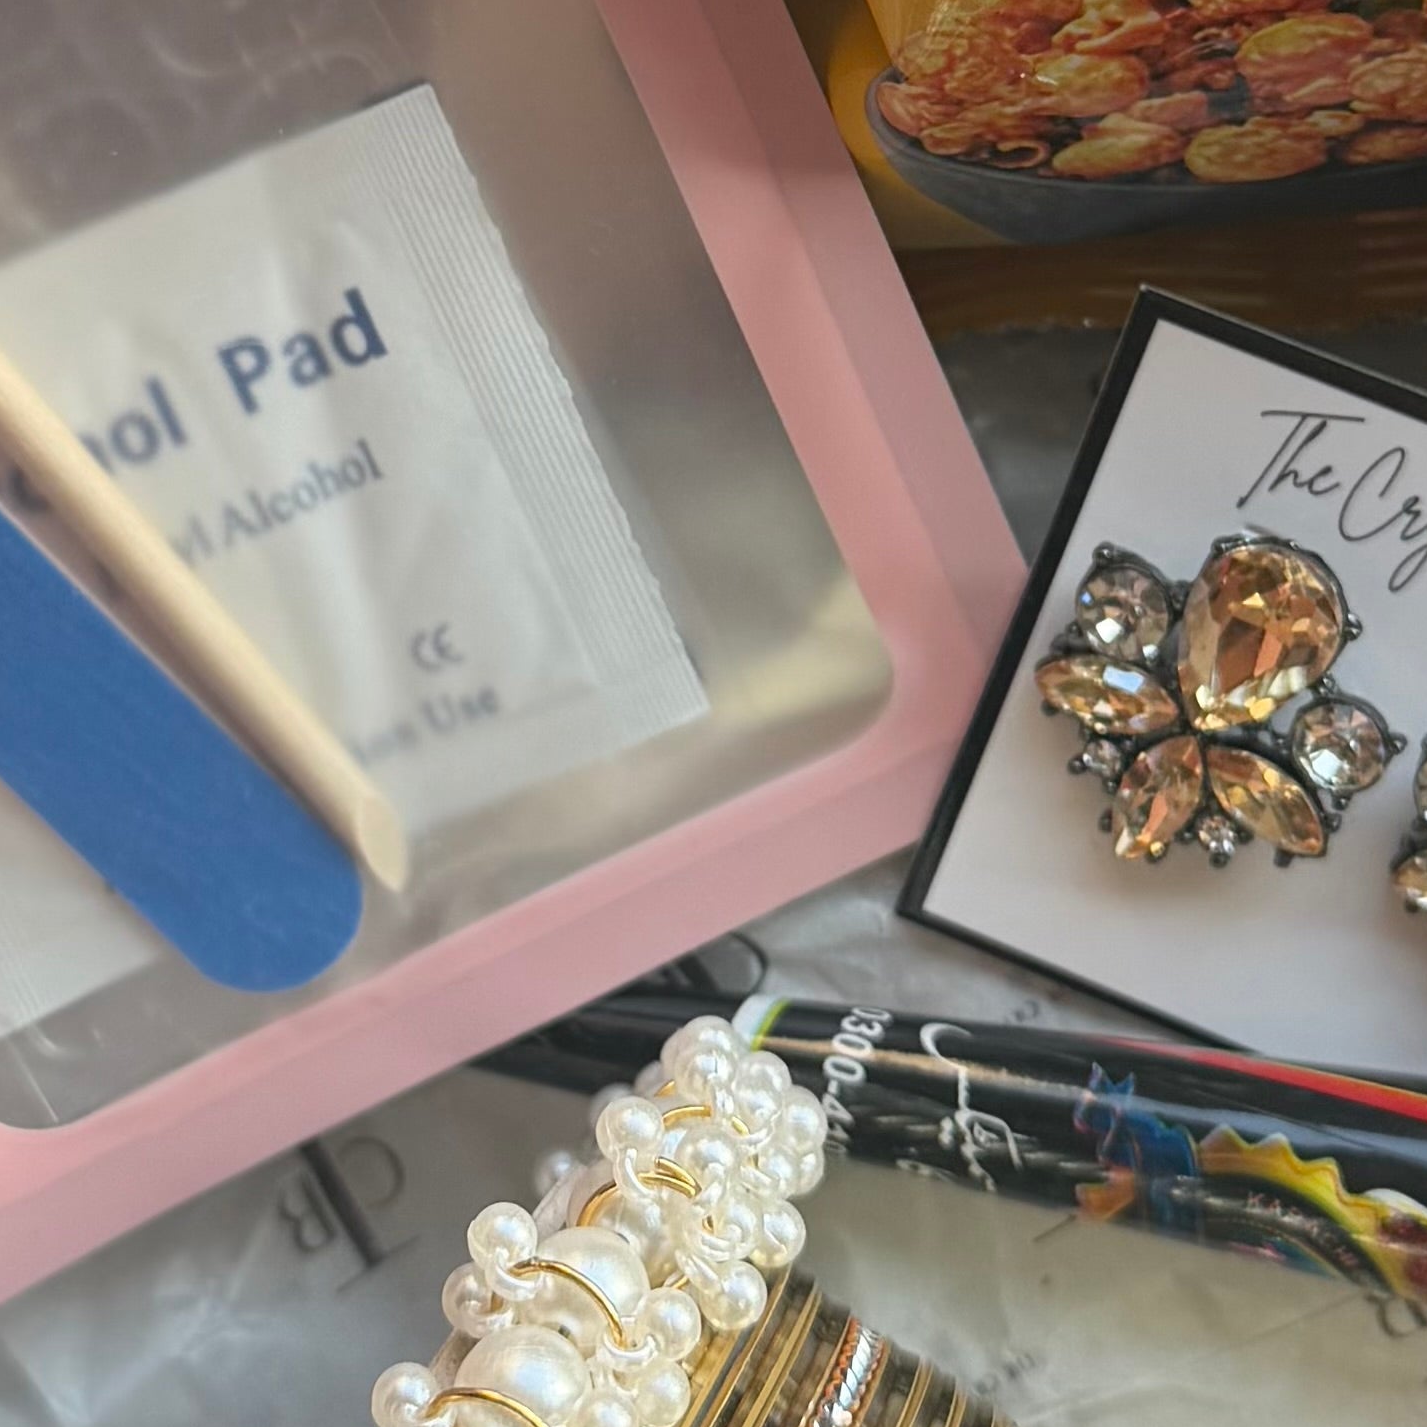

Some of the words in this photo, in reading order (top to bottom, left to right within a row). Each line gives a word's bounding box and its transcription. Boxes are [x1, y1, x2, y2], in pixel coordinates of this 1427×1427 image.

[216, 286, 390, 414] Pad
[221, 436, 384, 549] Alcohol
[1237, 410, 1365, 509] The
